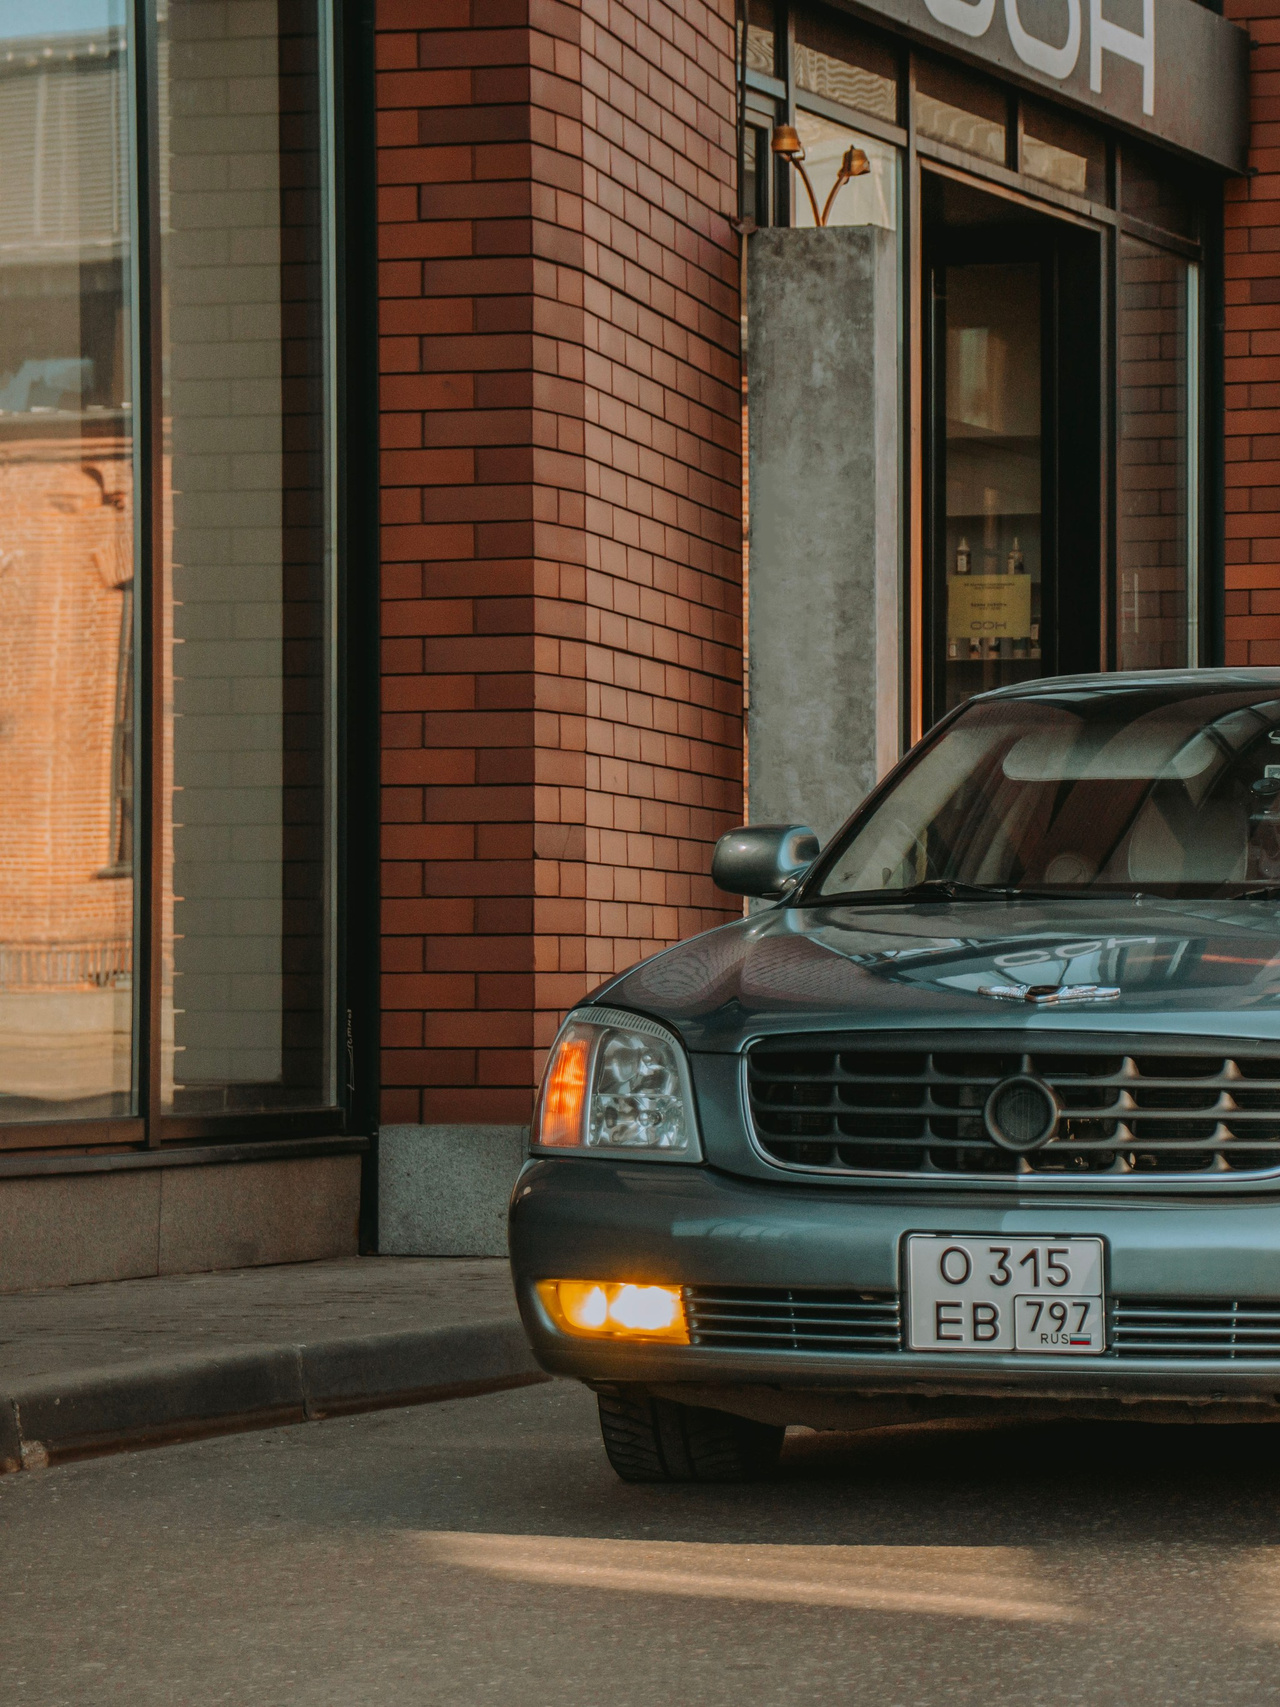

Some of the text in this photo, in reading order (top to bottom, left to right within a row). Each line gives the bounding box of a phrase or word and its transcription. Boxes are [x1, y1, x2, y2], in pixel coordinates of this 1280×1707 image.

[989, 1246, 1072, 1288] 315
[1026, 1300, 1091, 1333] 797
[1040, 1333, 1069, 1345] RUS
